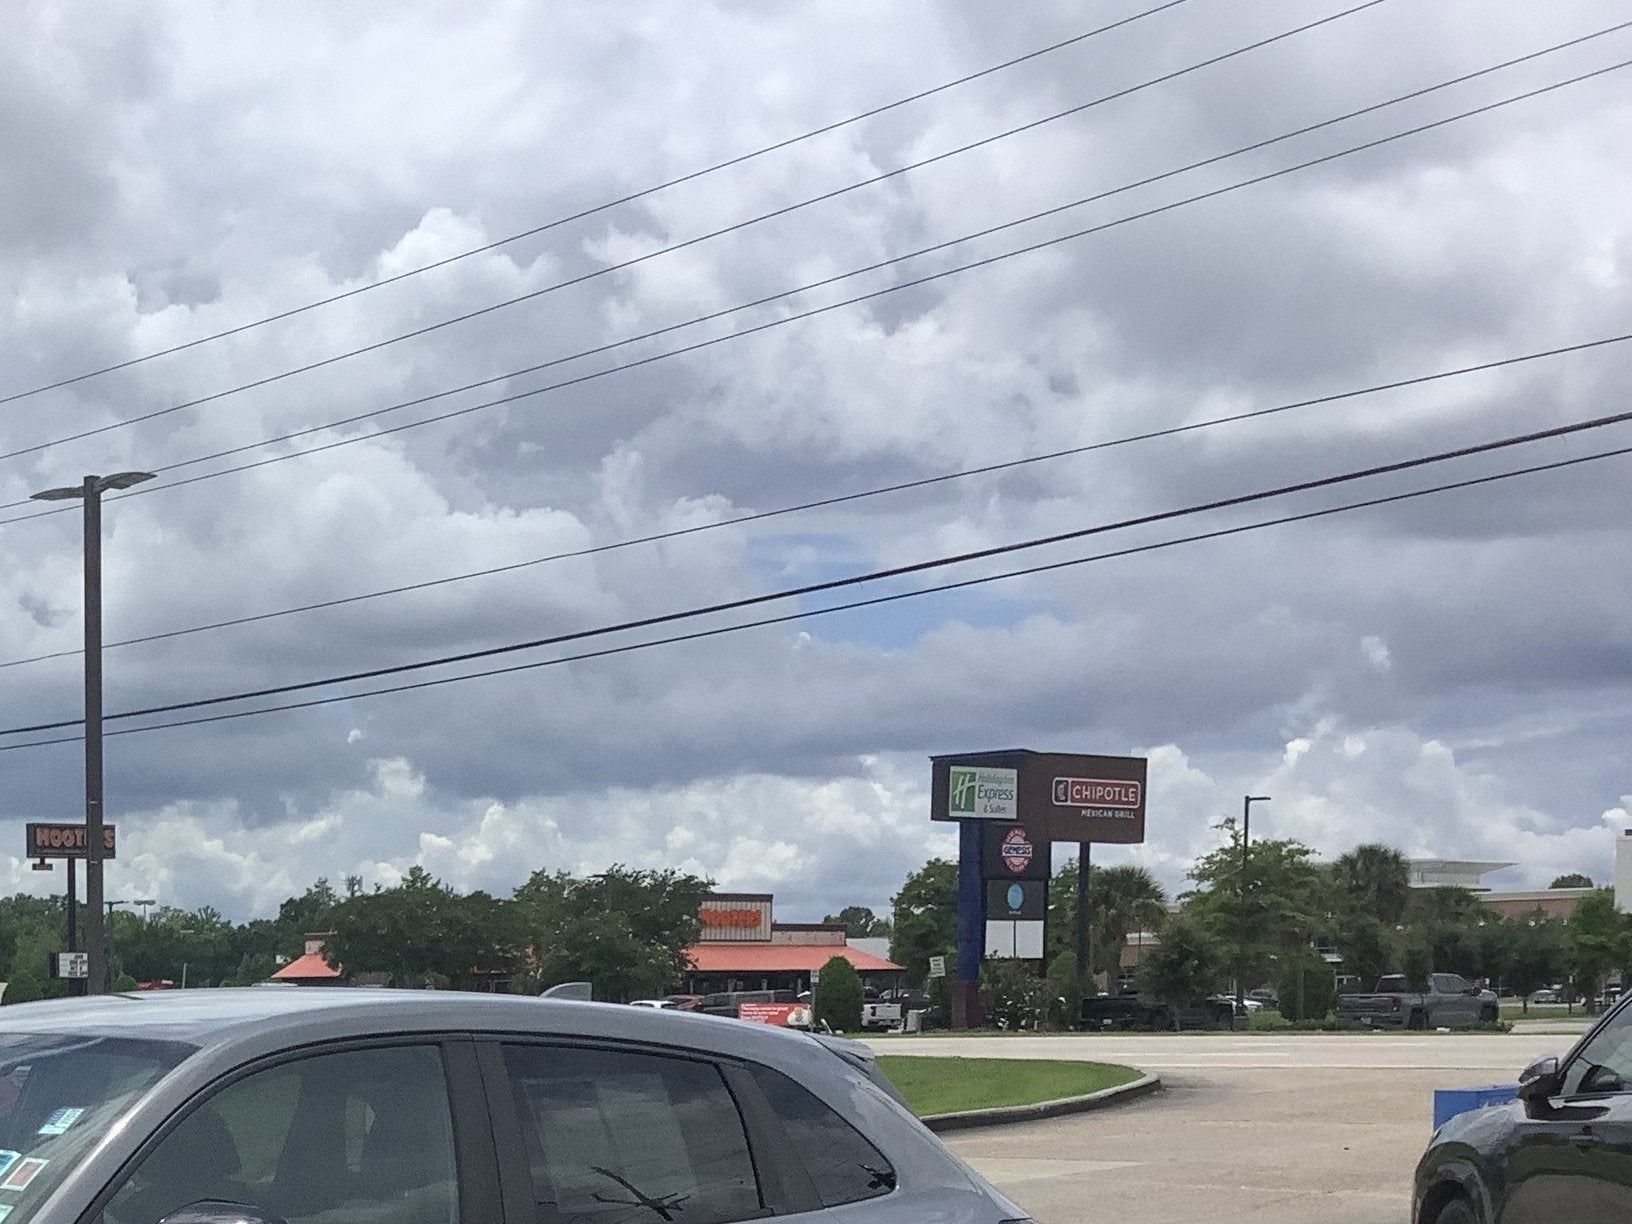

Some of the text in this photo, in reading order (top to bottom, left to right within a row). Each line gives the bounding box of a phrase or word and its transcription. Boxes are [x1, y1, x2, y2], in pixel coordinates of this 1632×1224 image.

[978, 785, 1014, 802] Express
[1072, 785, 1137, 802] CHIPOTLE
[1080, 808, 1135, 819] MEXICAN GRILL
[36, 827, 114, 848] HOOTS
